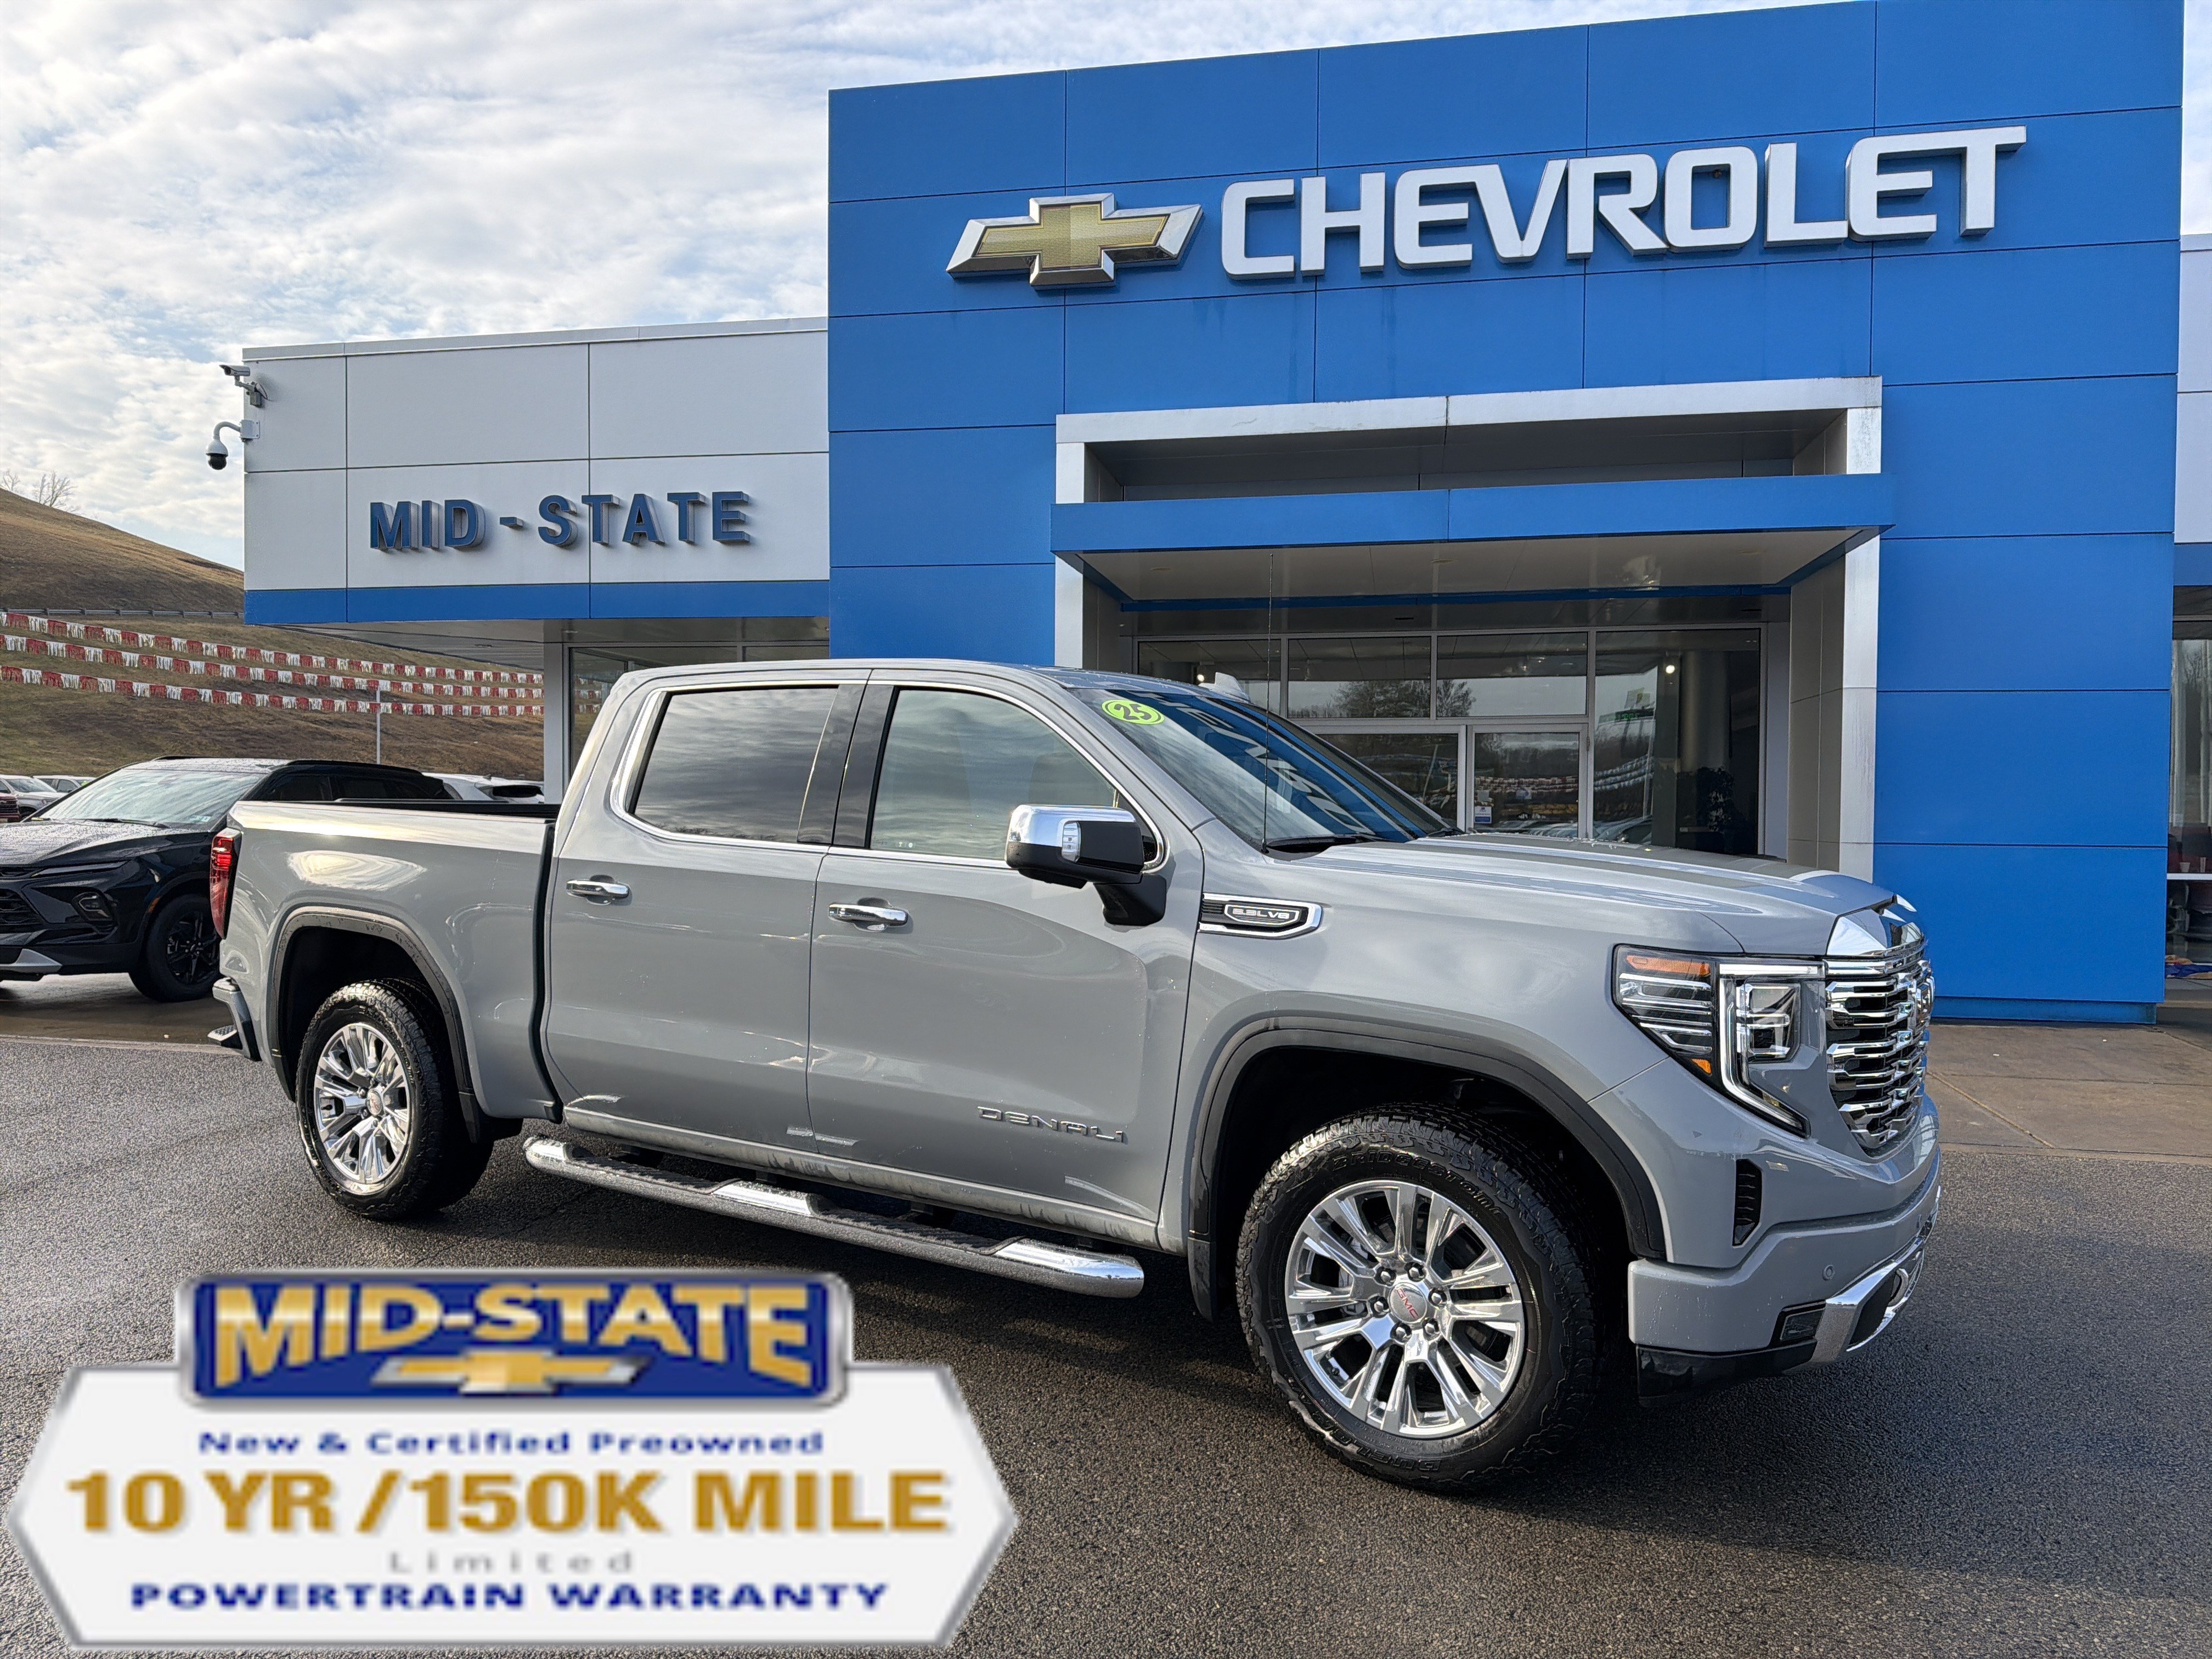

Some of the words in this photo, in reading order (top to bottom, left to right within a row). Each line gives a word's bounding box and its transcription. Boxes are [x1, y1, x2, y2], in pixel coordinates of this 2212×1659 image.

[1221, 126, 2027, 280] CHEVROLET
[1115, 703, 1153, 721] 25
[977, 1105, 1124, 1143] DENALI
[1396, 1287, 1420, 1321] GMC
